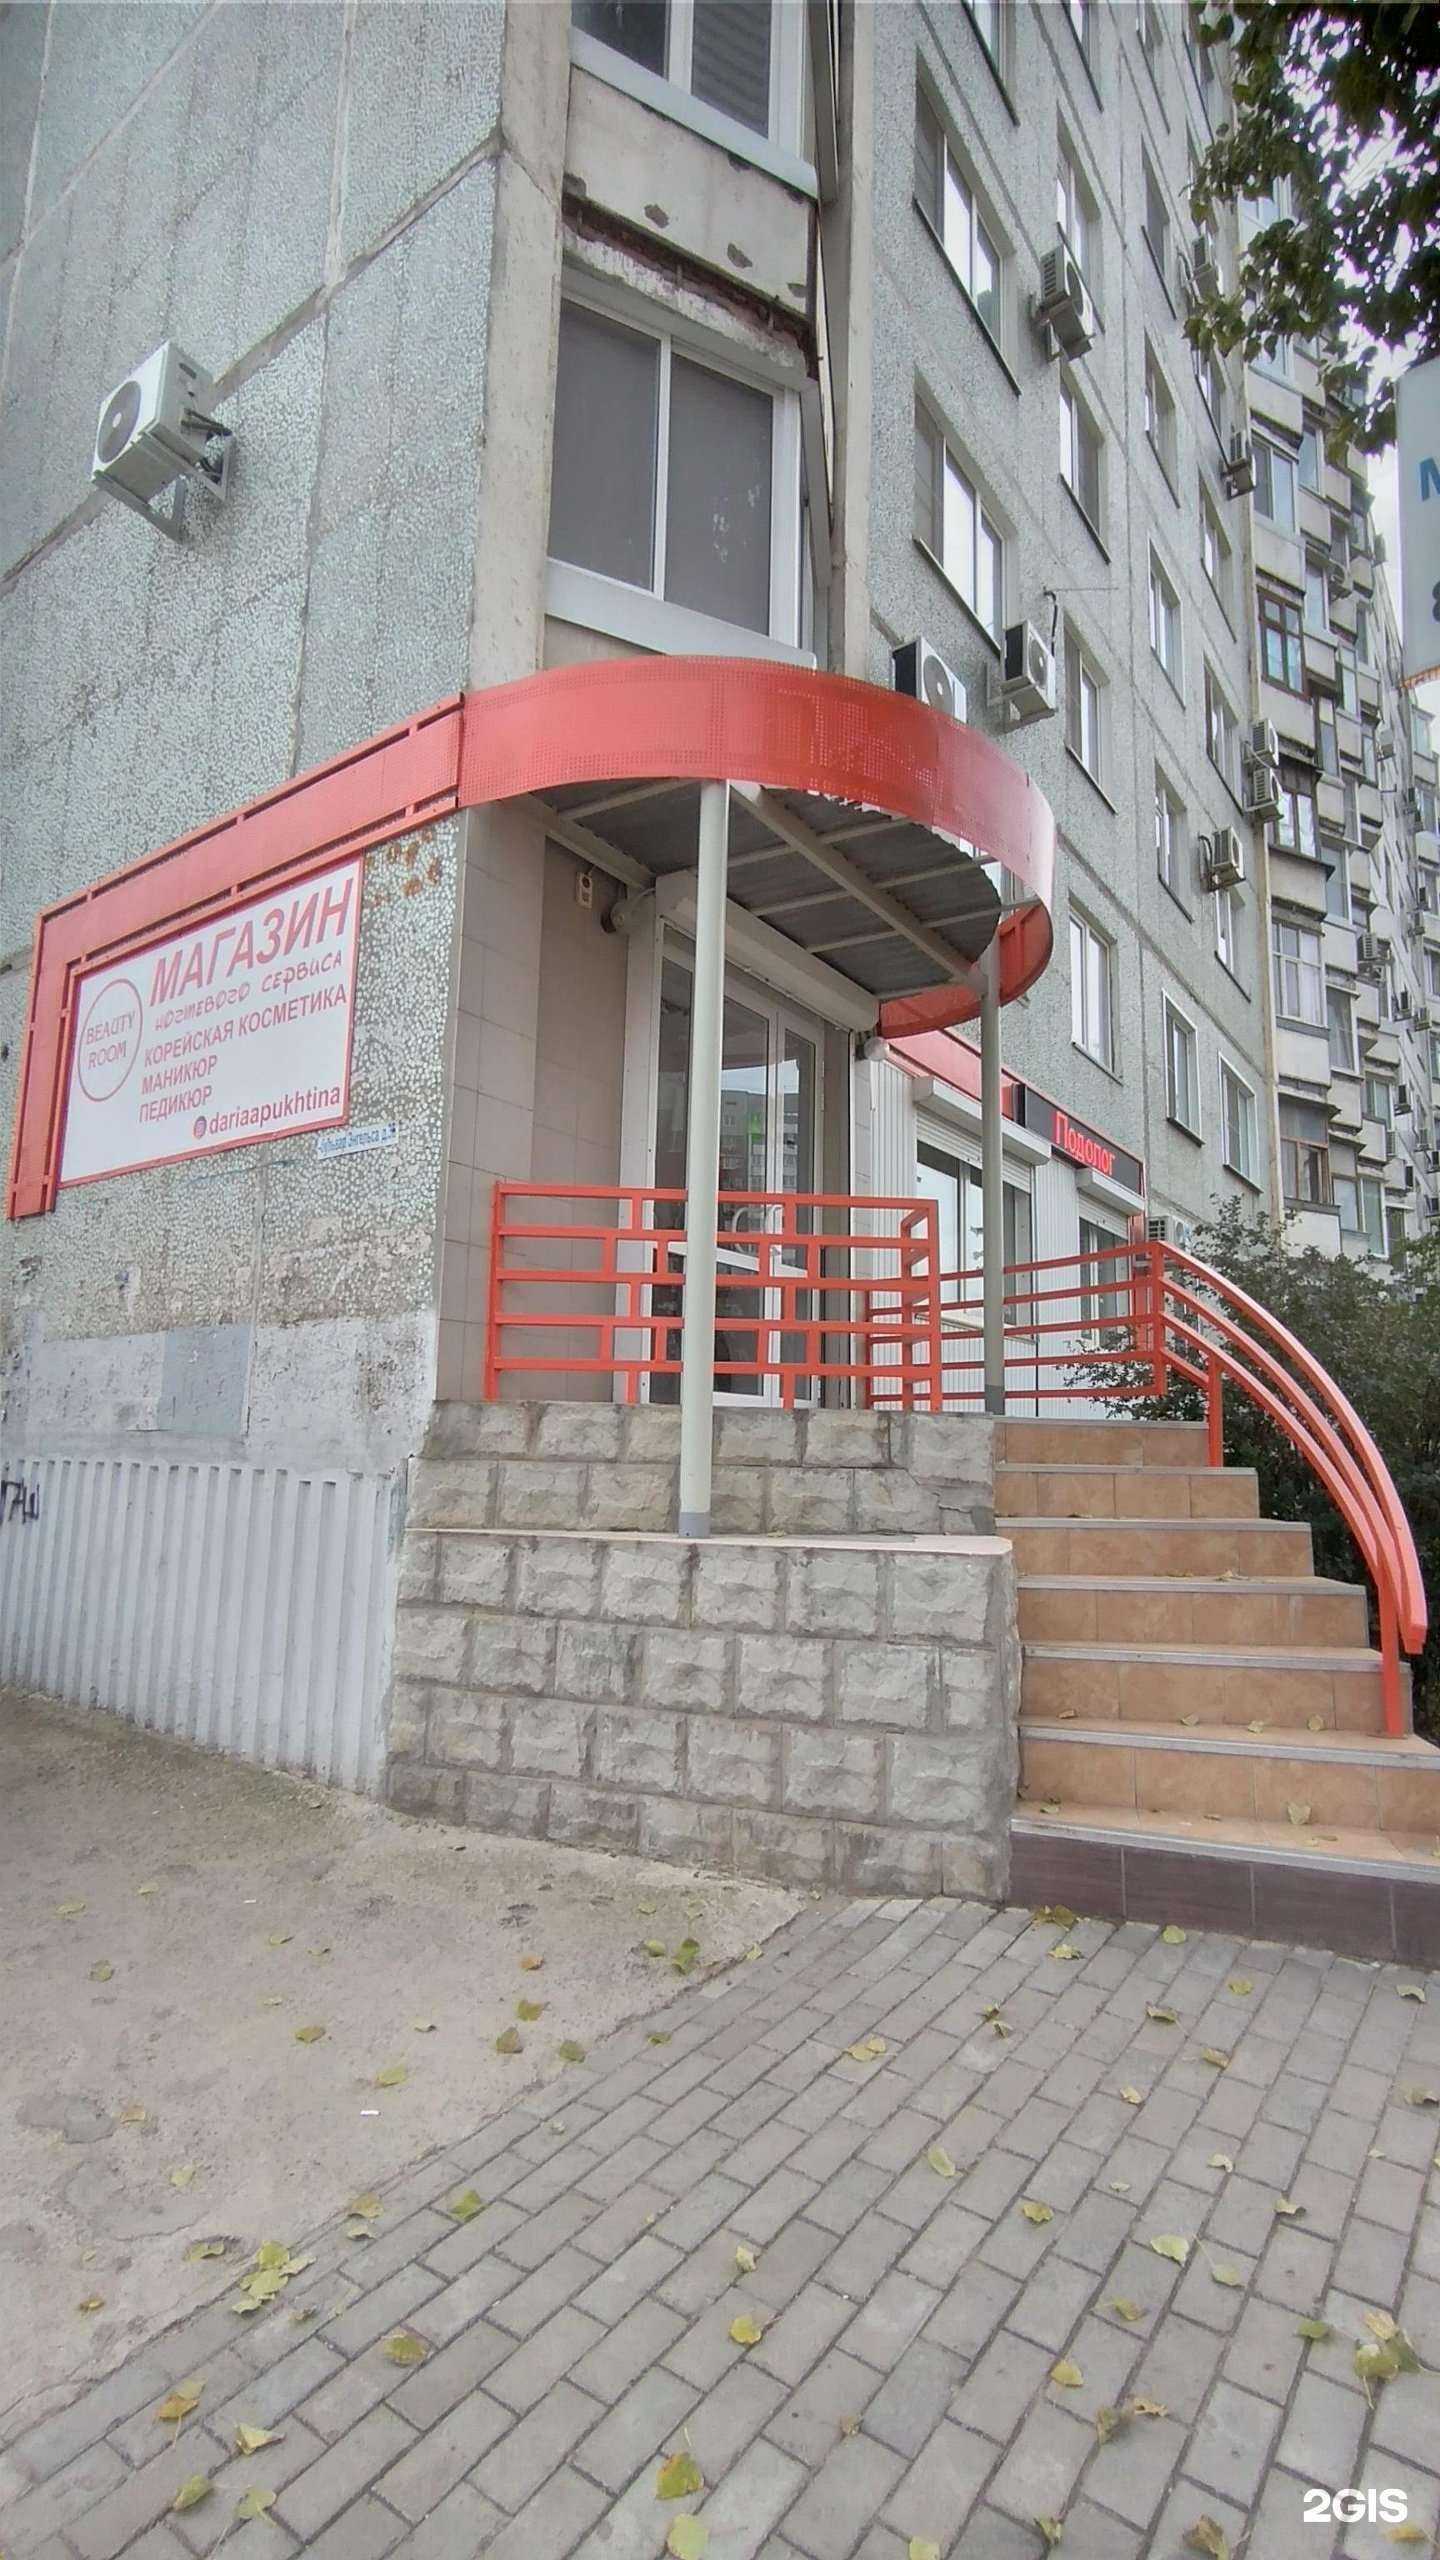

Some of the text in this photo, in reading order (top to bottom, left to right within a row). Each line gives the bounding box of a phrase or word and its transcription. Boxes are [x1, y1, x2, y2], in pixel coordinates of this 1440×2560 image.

[150, 878, 353, 1007] МАГАЗИН
[86, 1011, 136, 1045] BEAUTY
[144, 983, 347, 1067] КОРЕЙСКАЯ КОСМЕТИКА
[88, 1040, 127, 1070] ROOM
[141, 1055, 218, 1095] МАНИКЮР
[138, 1085, 213, 1124] ПЕДИКЮР
[209, 1086, 340, 1134] dariaapukhtina
[1056, 1111, 1116, 1175] Подолог
